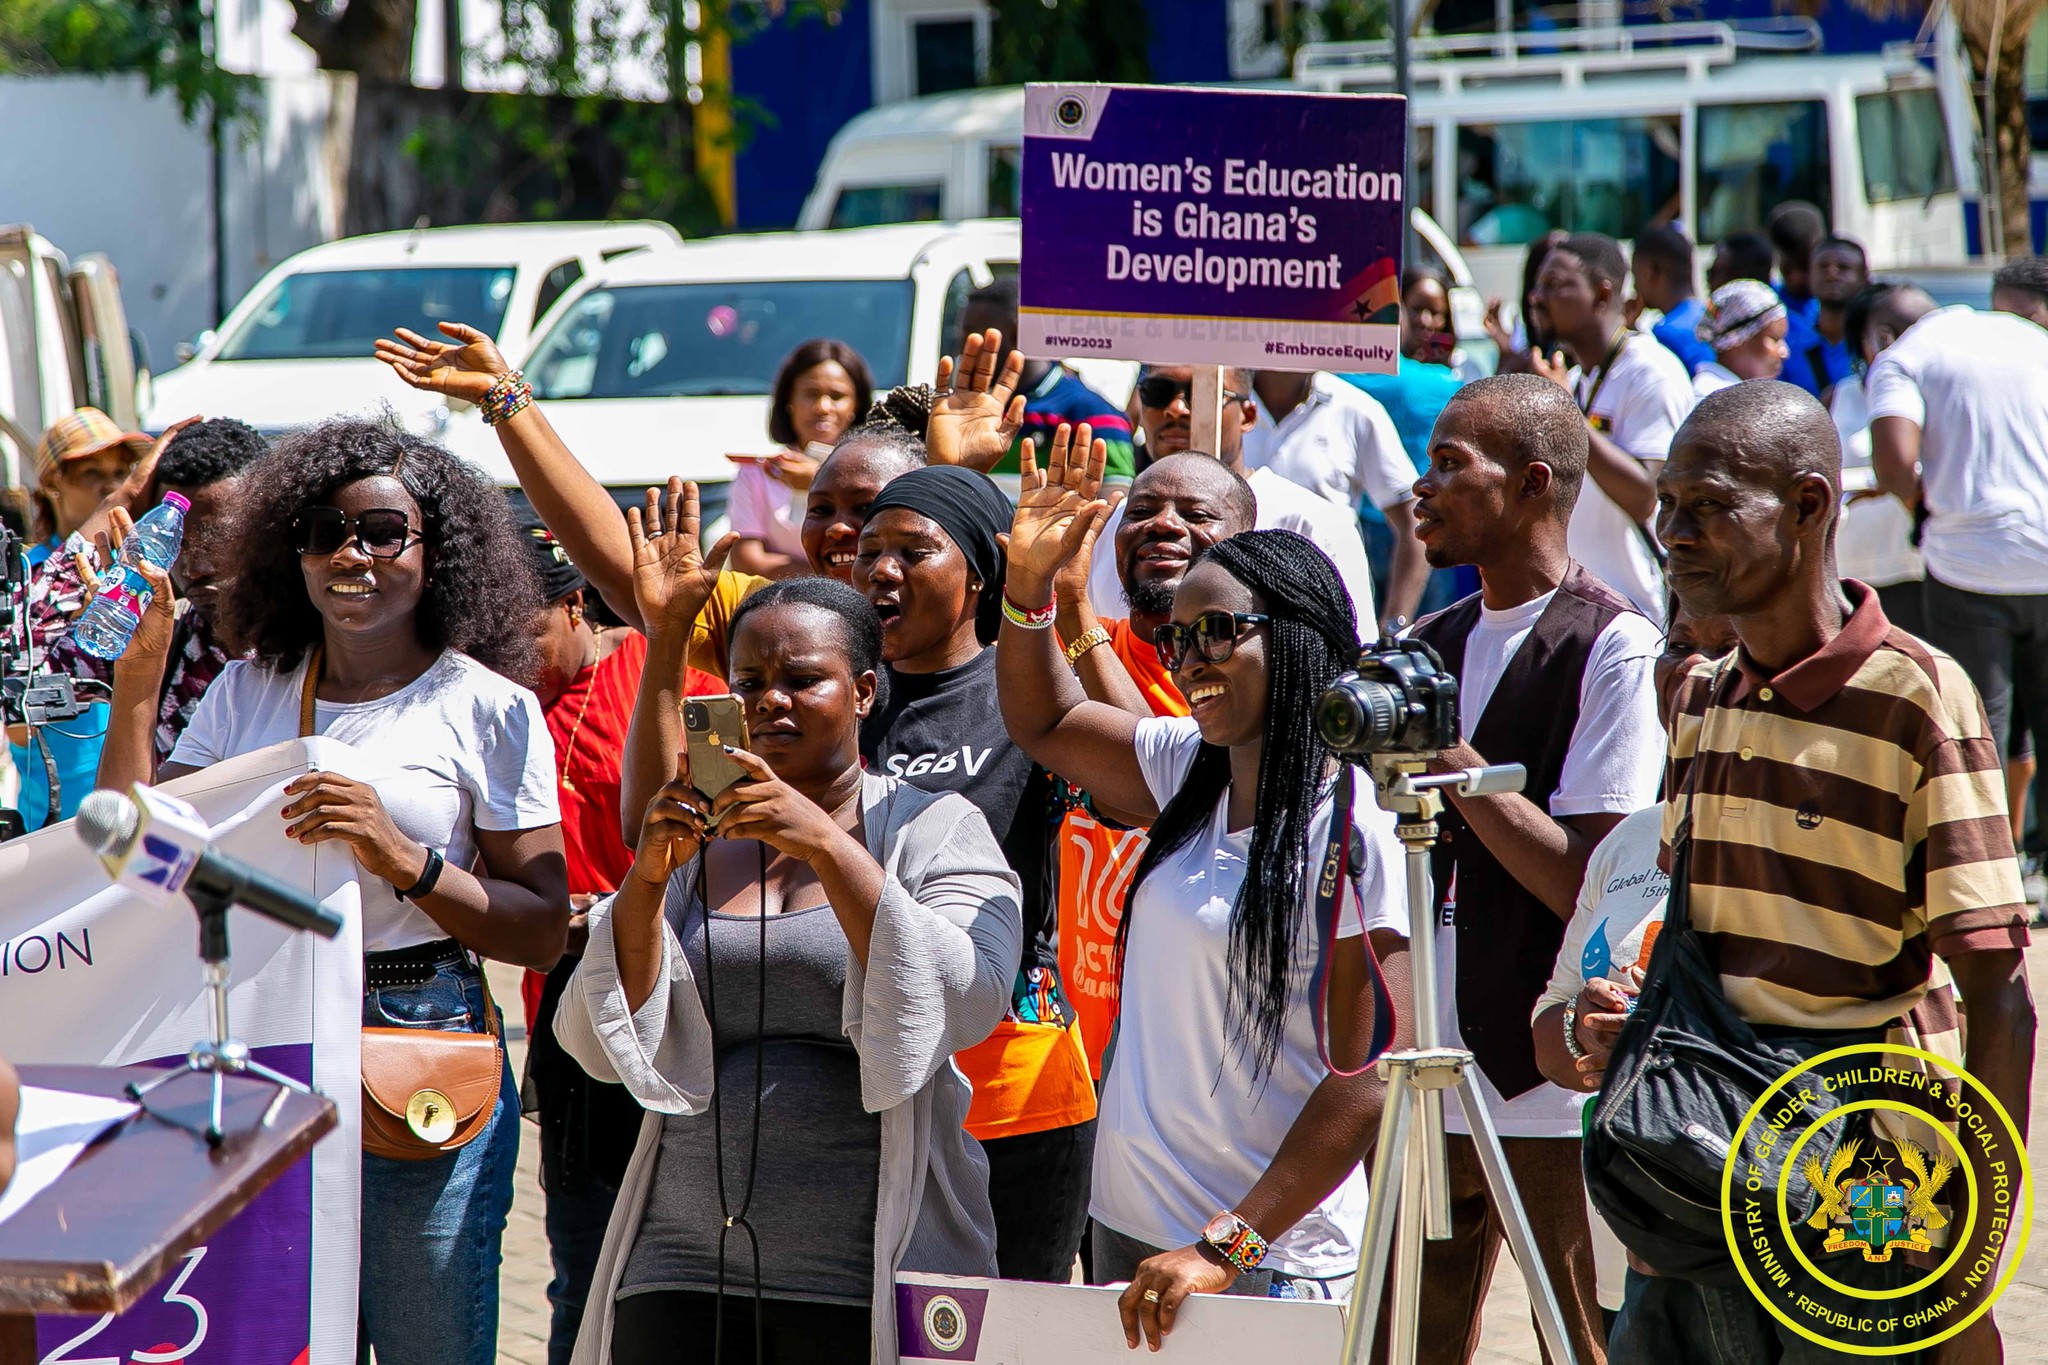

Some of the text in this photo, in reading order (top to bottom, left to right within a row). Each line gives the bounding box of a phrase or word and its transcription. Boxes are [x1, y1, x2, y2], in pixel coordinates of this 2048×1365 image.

[1051, 152, 1402, 201] Women's Education
[1132, 200, 1318, 244] is Ghana's
[1106, 244, 1342, 293] Development
[1045, 335, 1113, 349] #IWD2023
[1264, 342, 1394, 362] #EmbraceEquity
[1320, 842, 1341, 898] EOS
[1607, 869, 1652, 893] Global
[1642, 884, 1669, 898] 15th
[0, 928, 93, 976] ION
